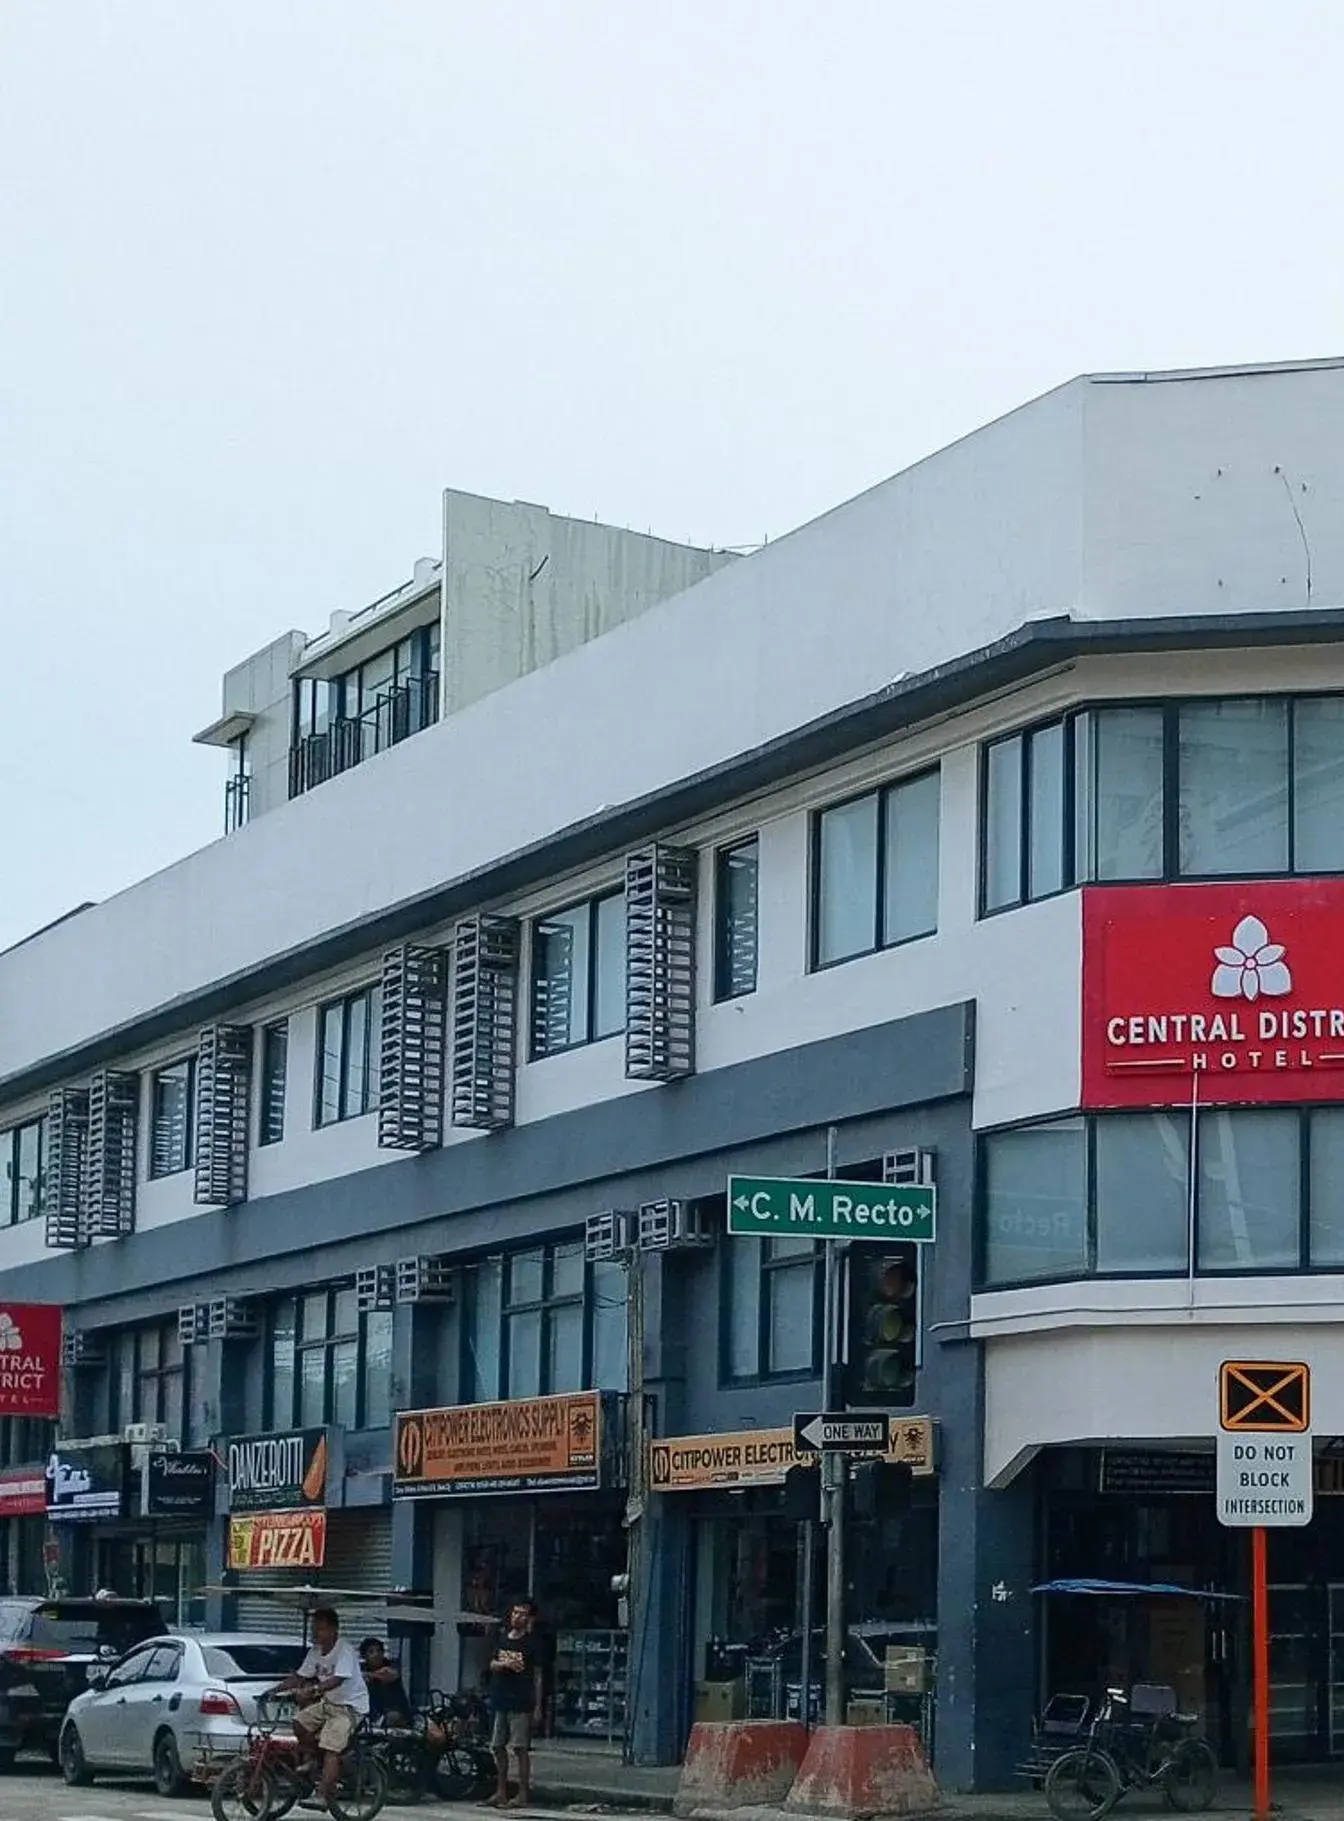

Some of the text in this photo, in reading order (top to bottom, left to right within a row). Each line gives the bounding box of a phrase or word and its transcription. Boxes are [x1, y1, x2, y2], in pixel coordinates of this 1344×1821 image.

[1107, 1014, 1246, 1045] CENTRAL
[1193, 1050, 1312, 1069] HOTEL
[751, 1191, 913, 1226] C. M. Recto
[823, 1423, 880, 1440] ONE WAY
[672, 1444, 741, 1471] CITIPOWER
[1234, 1446, 1295, 1460] DO NOT
[1240, 1472, 1290, 1487] BLOCK
[1225, 1499, 1305, 1514] INTERSECTION
[259, 1527, 315, 1566] PIZZA
